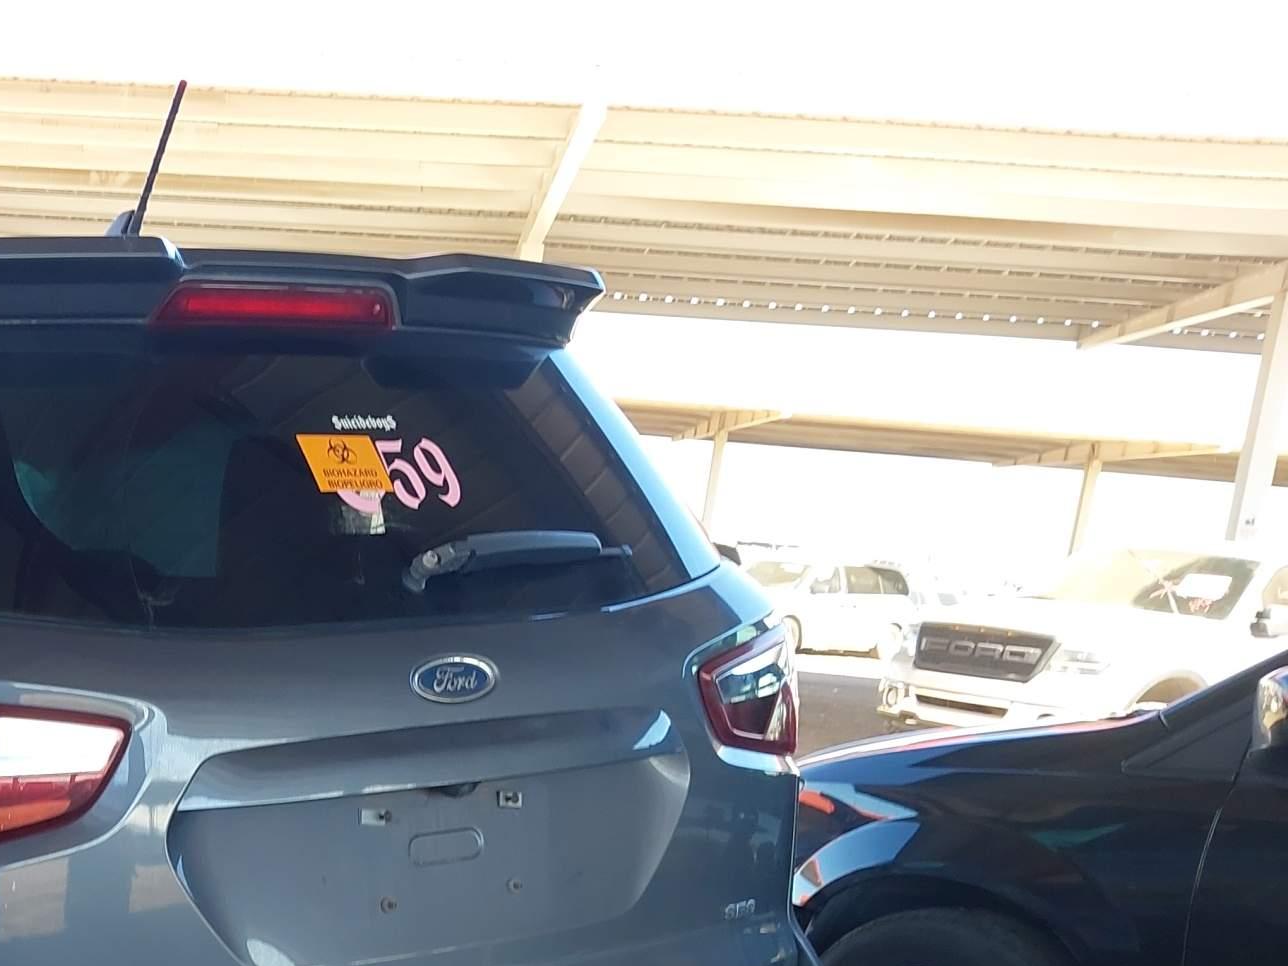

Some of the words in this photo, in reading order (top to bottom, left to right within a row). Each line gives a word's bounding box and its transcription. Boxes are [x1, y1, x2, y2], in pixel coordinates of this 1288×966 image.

[322, 468, 378, 477] BIOHAZARD
[327, 480, 384, 489] BIOPELIGRO
[920, 636, 1043, 665] FORD
[433, 666, 478, 694] Ford
